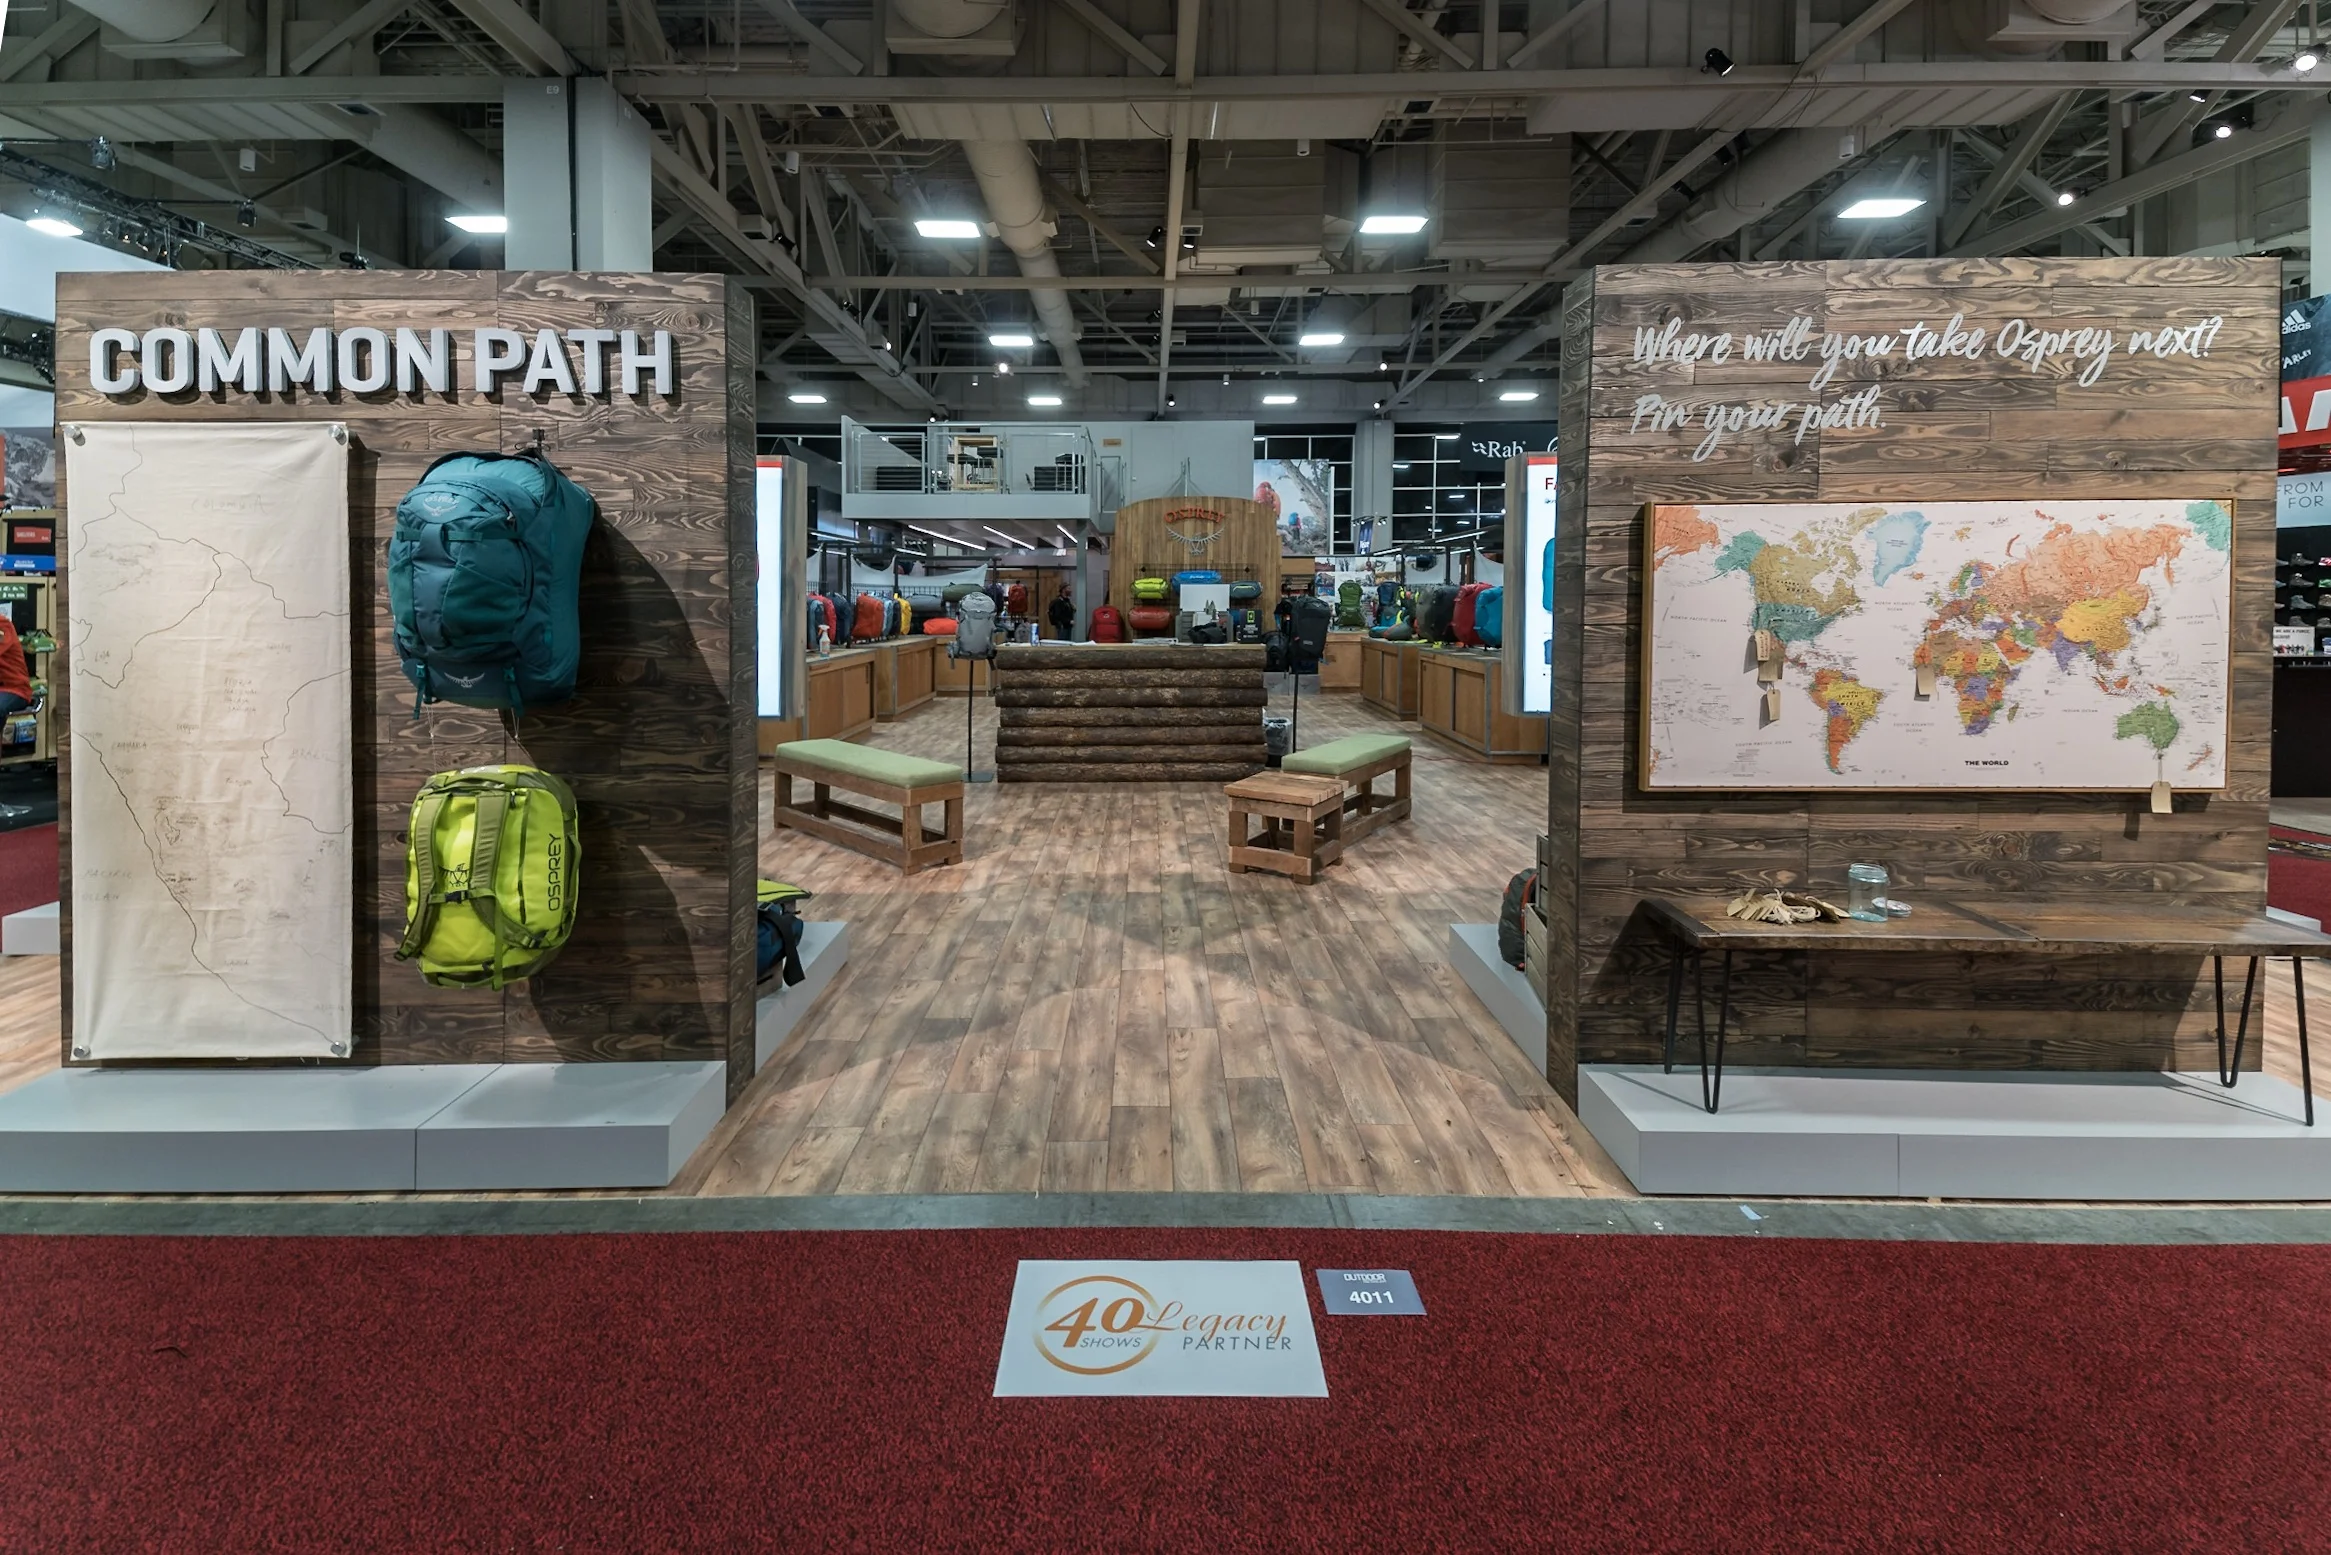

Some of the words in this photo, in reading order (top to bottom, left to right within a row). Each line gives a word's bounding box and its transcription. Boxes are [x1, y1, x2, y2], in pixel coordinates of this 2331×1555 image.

[546, 86, 560, 95] E9
[90, 327, 451, 394] COMMON
[474, 328, 674, 395] PATH
[1633, 316, 1733, 365] Where
[1743, 316, 1813, 362] will
[1808, 330, 1900, 392] you
[1899, 312, 1986, 361] take
[1996, 318, 2121, 388] Osprey
[2128, 315, 2223, 358] next?
[2282, 348, 2312, 370] ARLEY
[1630, 393, 1693, 436] Pin
[1691, 402, 1798, 463] your
[1793, 384, 1887, 446] path.
[1487, 440, 1524, 459] Rab
[2288, 495, 2324, 509] FOR
[548, 833, 562, 912] OSPREY
[1343, 1273, 1386, 1281] OUTDOOR
[1349, 1290, 1394, 1304] 4011
[1044, 1297, 1145, 1348] 40
[1127, 1300, 1287, 1343] Legacy
[1080, 1337, 1142, 1349] SHOWS
[1183, 1336, 1292, 1350] PARTNER
